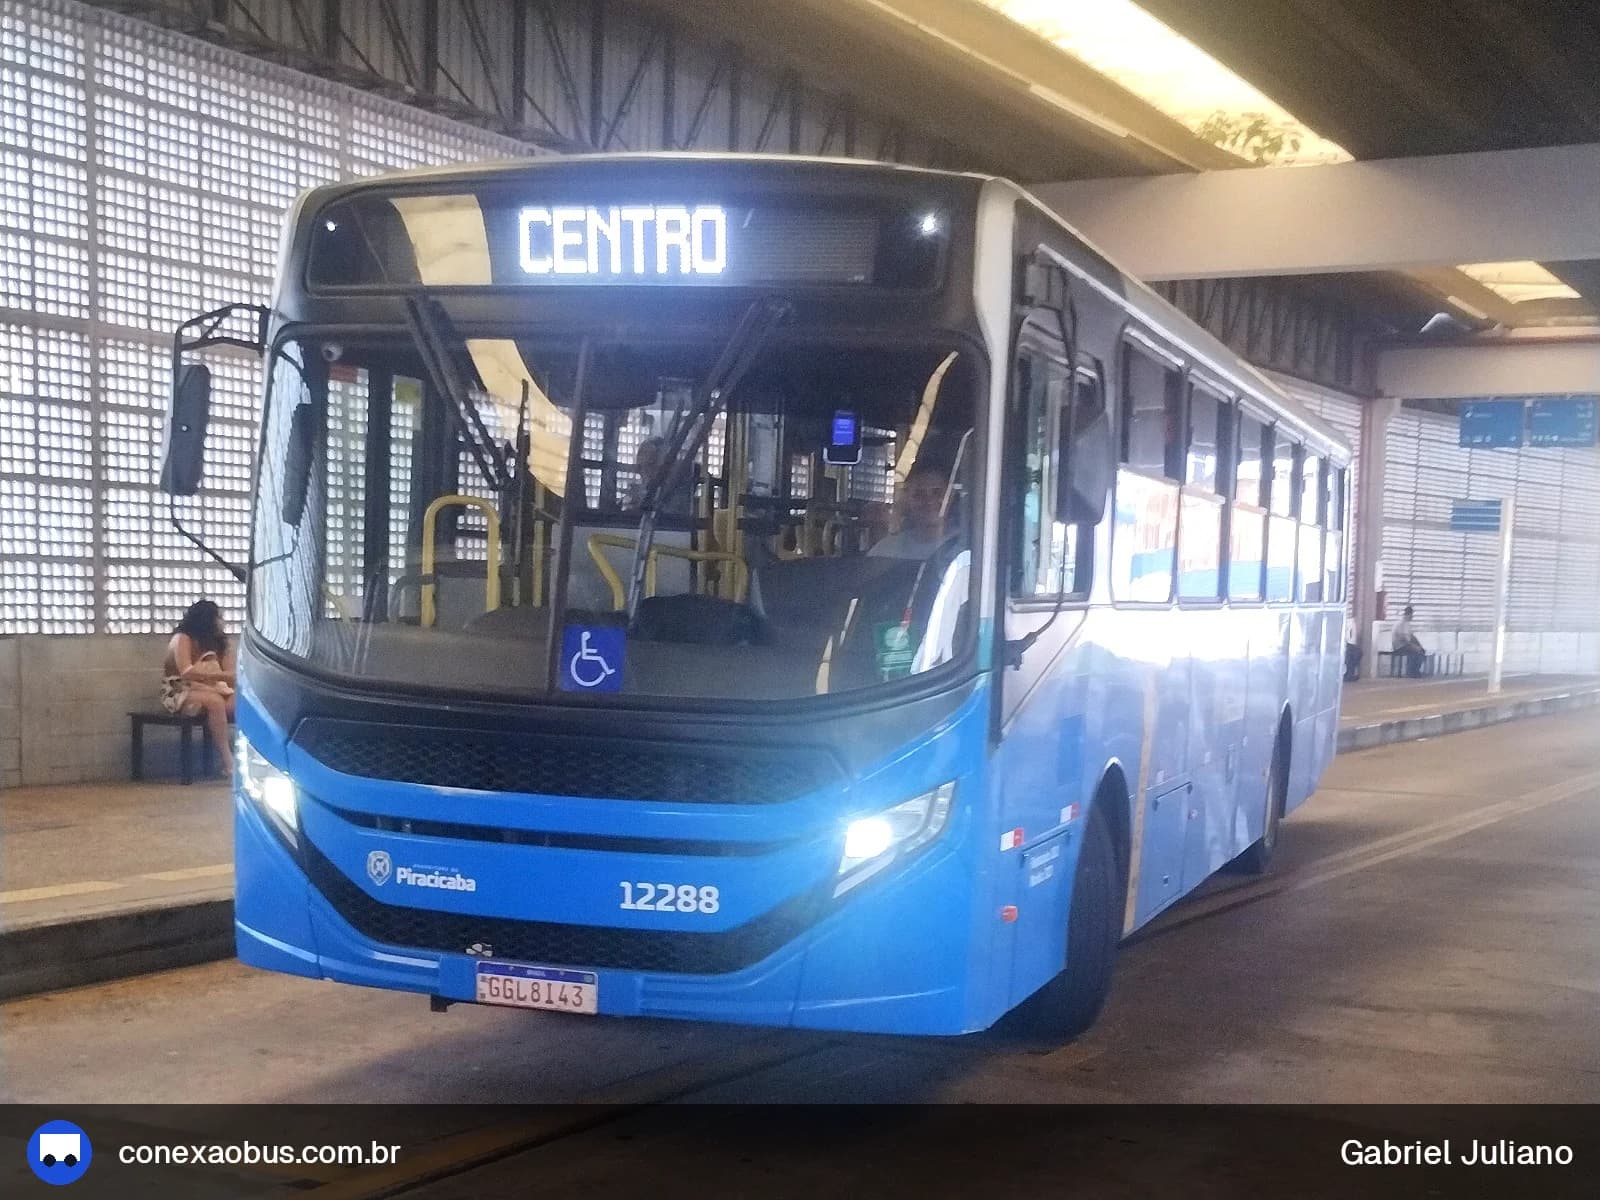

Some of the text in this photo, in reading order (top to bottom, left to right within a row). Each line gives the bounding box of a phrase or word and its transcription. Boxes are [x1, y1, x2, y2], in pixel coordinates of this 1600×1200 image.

[519, 205, 727, 274] CENTRO
[396, 866, 477, 892] Piracicaba
[619, 881, 720, 914] 12288
[488, 976, 583, 1007] GGL8I43
